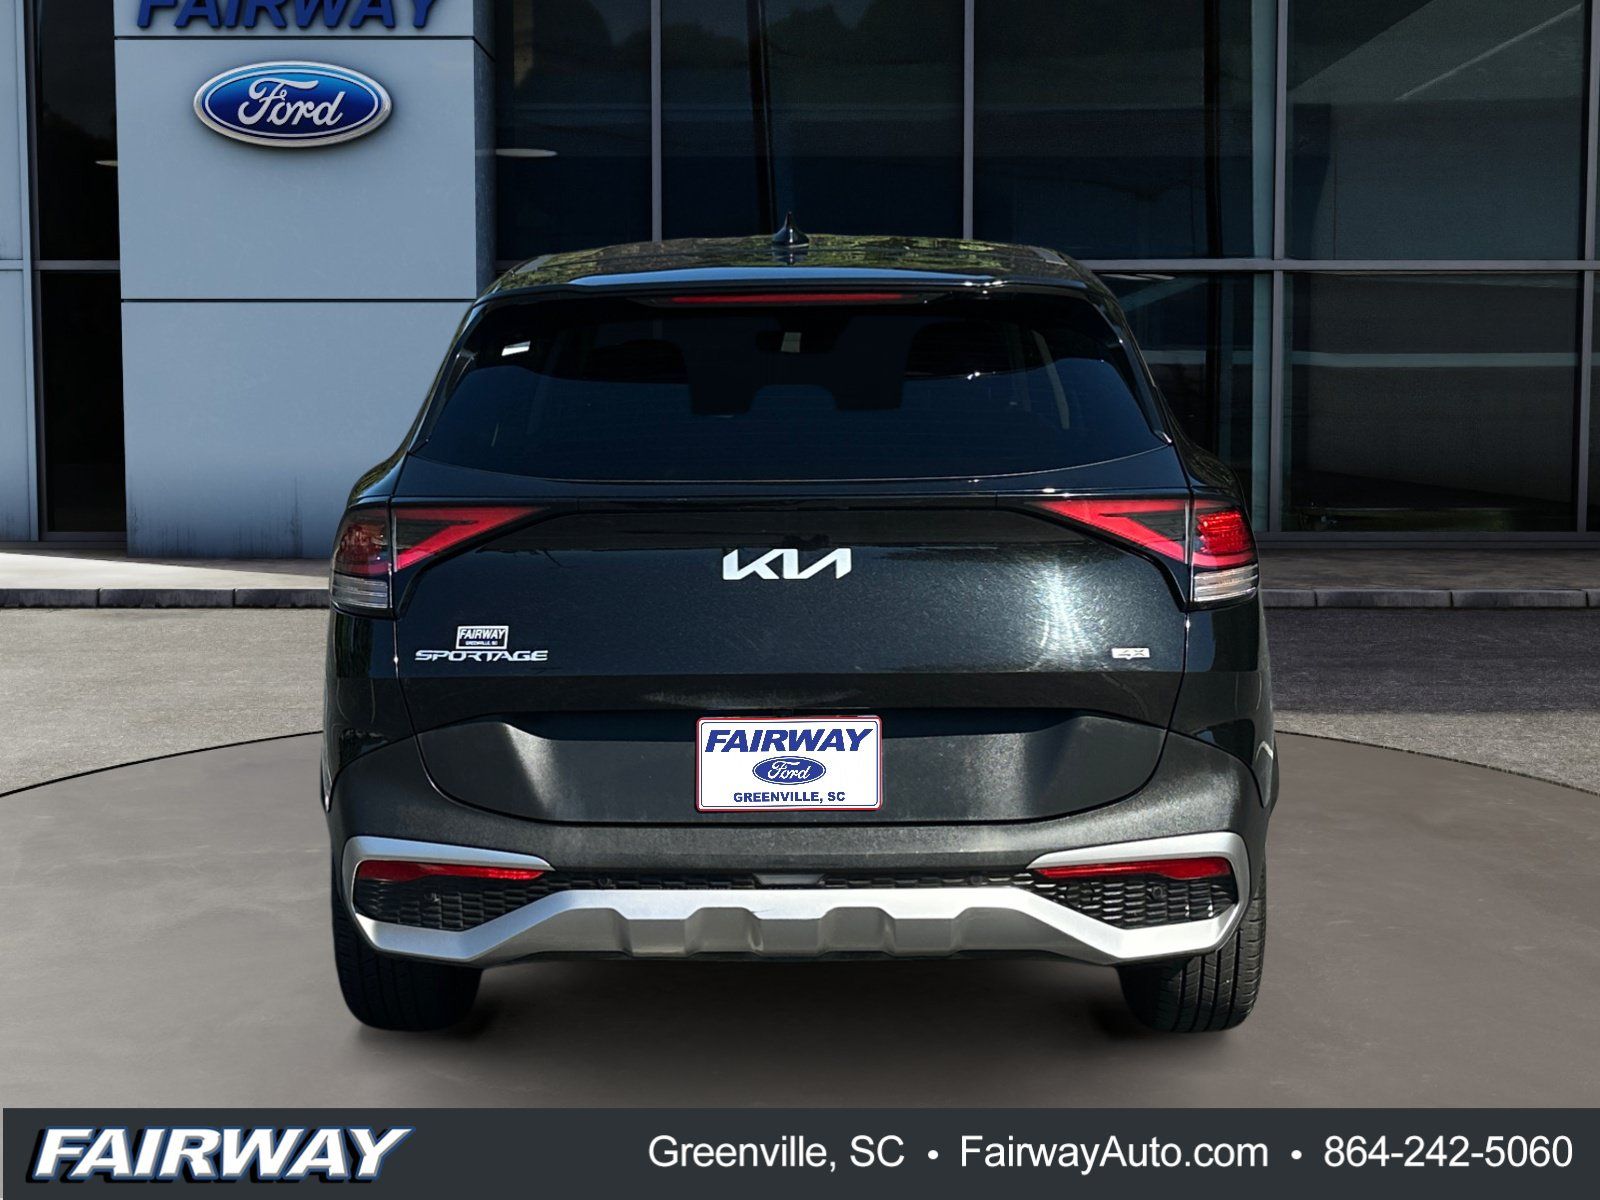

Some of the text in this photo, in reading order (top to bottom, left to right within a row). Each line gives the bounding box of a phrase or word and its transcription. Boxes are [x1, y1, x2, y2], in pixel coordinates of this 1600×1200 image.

[136, 0, 438, 28] FAIRWAY
[237, 77, 346, 126] Ford
[723, 548, 851, 580] KIA
[459, 629, 506, 640] FAIRWAY
[414, 650, 549, 662] SPORTAGE
[704, 728, 873, 752] FAIRWAY
[767, 760, 811, 780] Ford
[733, 791, 846, 803] GREENVILLE, SC
